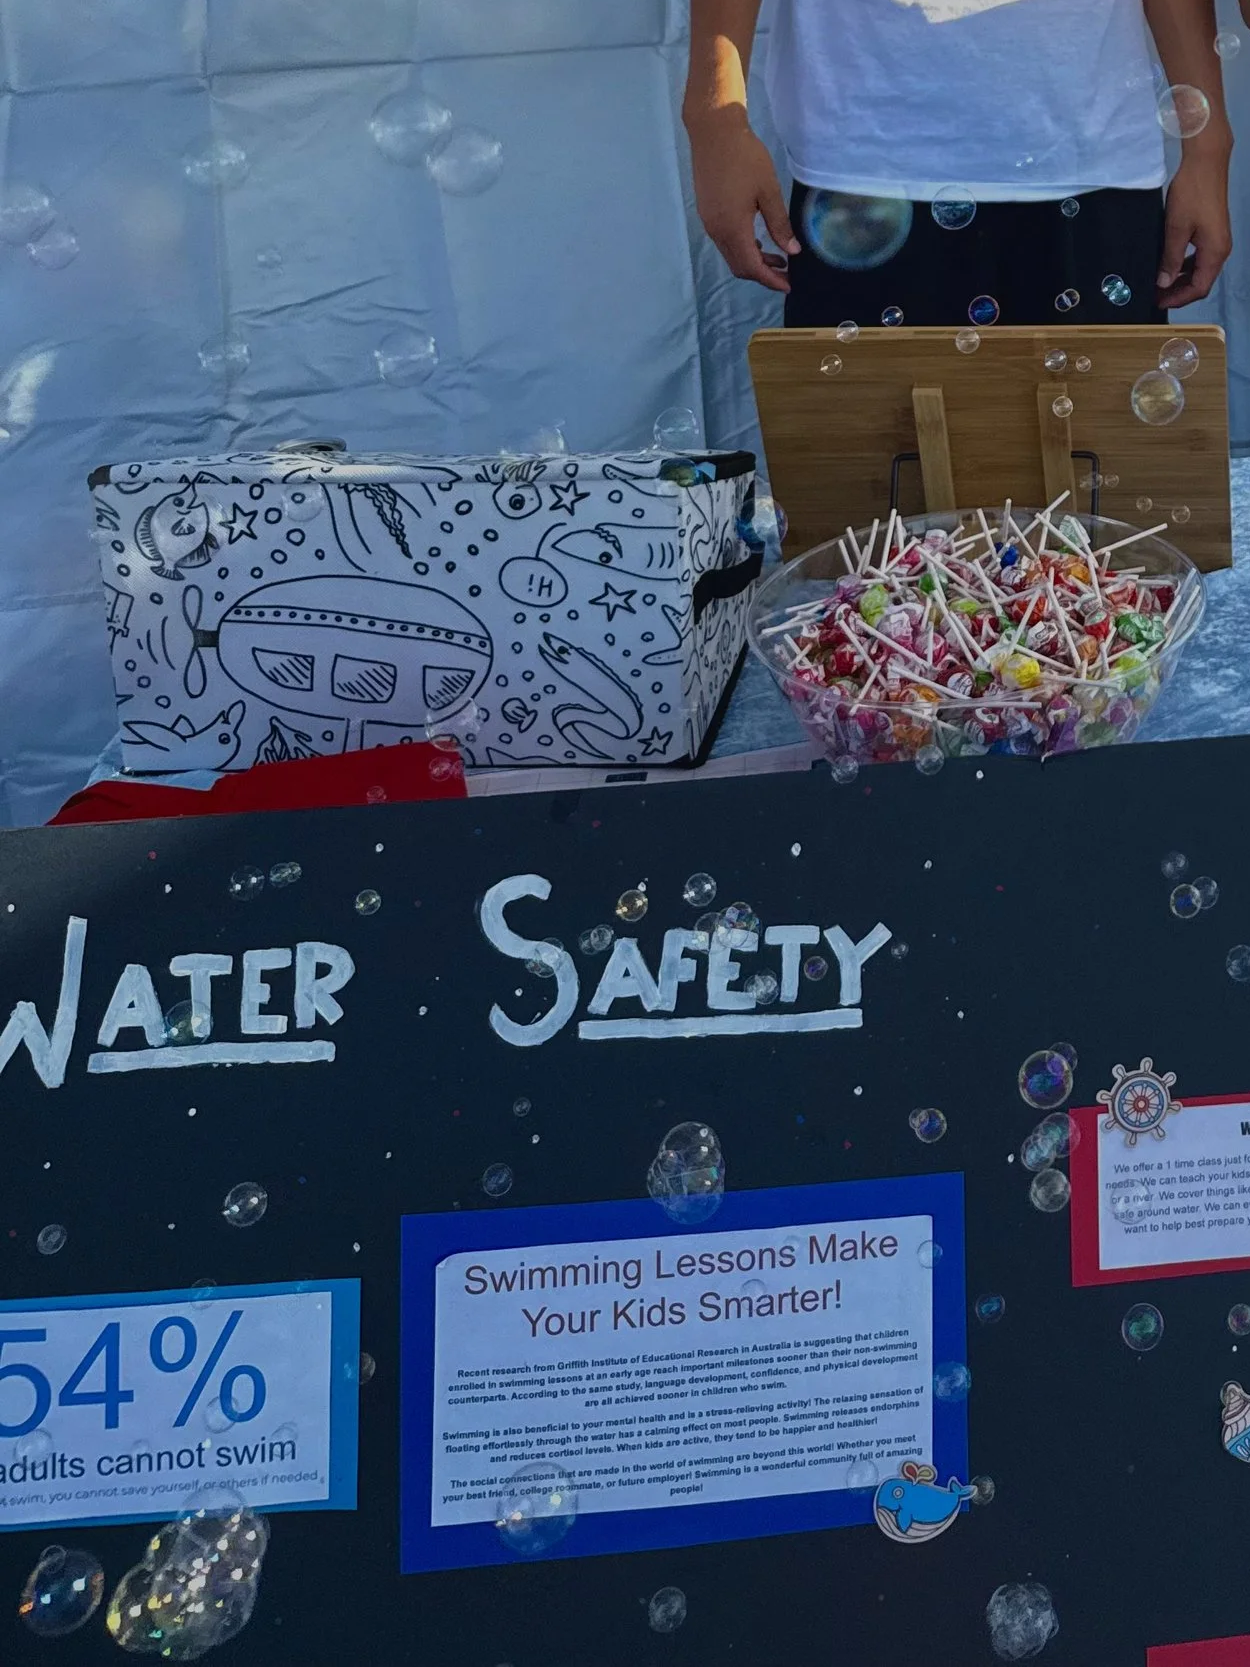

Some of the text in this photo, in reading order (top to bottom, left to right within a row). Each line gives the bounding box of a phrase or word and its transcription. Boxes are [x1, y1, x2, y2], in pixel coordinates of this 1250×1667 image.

[480, 874, 892, 1047] SAFETY
[1114, 1164, 1129, 1173] We
[1133, 1162, 1154, 1172] offer
[1157, 1162, 1162, 1170] a
[1166, 1160, 1170, 1169] 1
[1174, 1160, 1194, 1168] time
[1197, 1157, 1222, 1167] class
[1224, 1155, 1241, 1167] just
[464, 1230, 898, 1294] Swimming Lessons Make
[521, 1279, 840, 1337] Your Kids Smarter!
[0, 1310, 266, 1439] 54%
[457, 1368, 489, 1377] Recent
[492, 1365, 531, 1375] research
[533, 1364, 555, 1372] from
[557, 1359, 588, 1370] Griffith
[591, 1357, 627, 1367] Institute
[630, 1355, 640, 1363] of
[642, 1350, 694, 1362] Educational
[697, 1346, 738, 1357] Research
[741, 1345, 749, 1353] in
[751, 1342, 791, 1352] Australia
[803, 1335, 852, 1347] suggesting
[854, 1332, 871, 1341] that
[873, 1329, 908, 1339] children
[97, 1443, 206, 1477] cannot
[216, 1437, 296, 1467] swim
